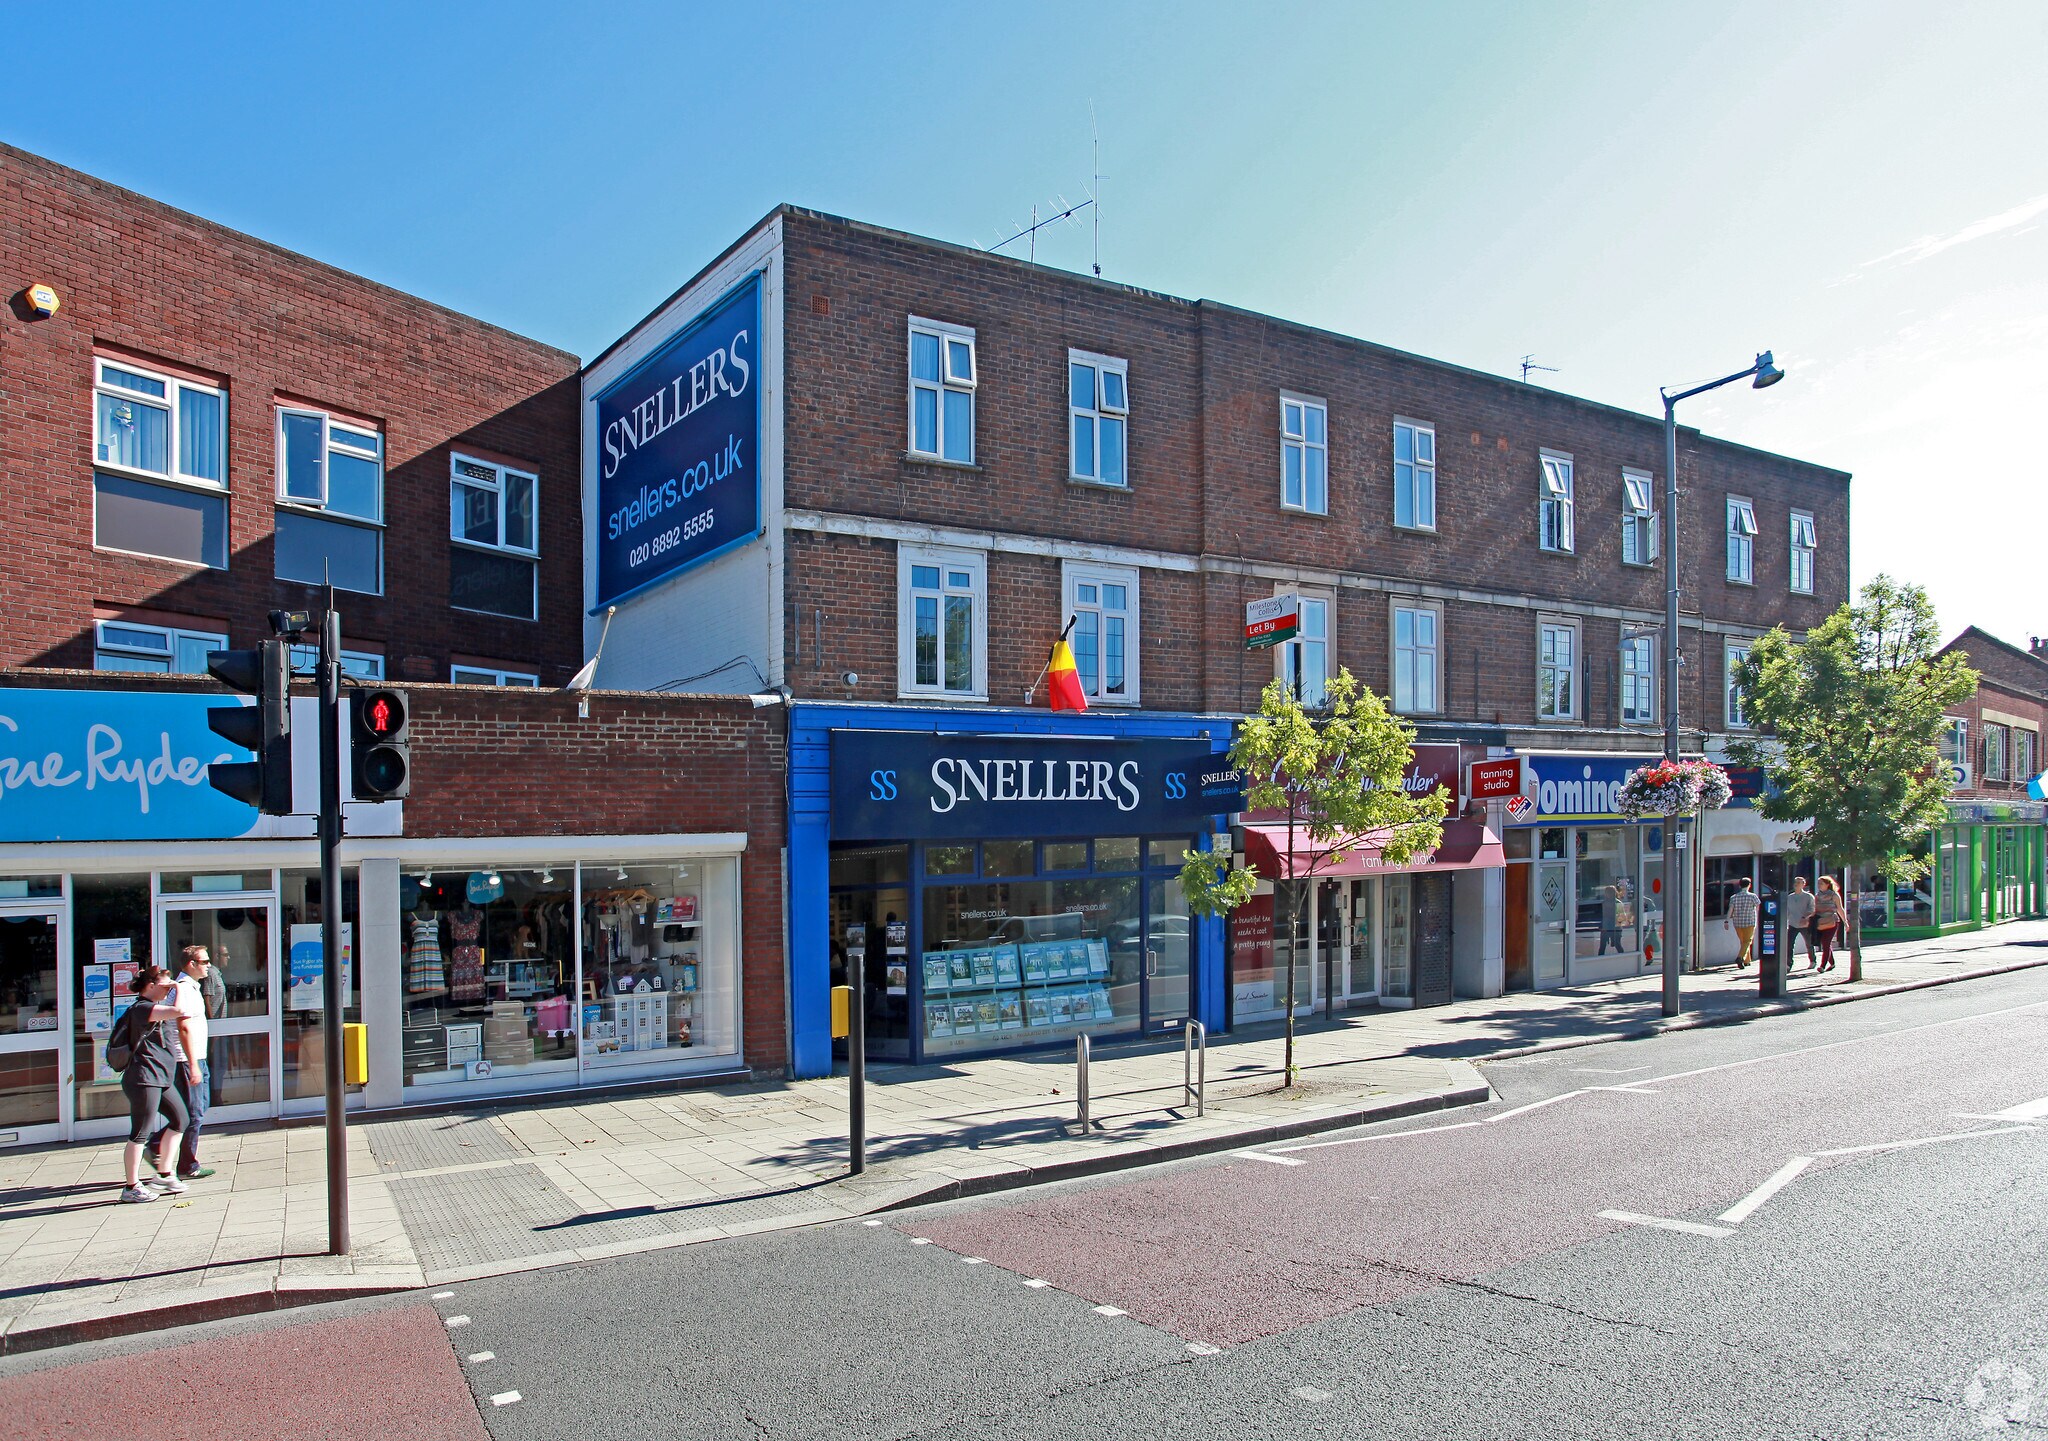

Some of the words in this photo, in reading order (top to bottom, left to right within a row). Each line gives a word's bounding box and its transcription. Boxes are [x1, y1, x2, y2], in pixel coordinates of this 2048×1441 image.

[604, 329, 749, 479] SNELLERS
[608, 433, 743, 540] snellers.co.uk
[629, 542, 649, 567] 020
[652, 526, 680, 557] 8892
[683, 508, 714, 540] 5555
[1249, 600, 1277, 611] Milestone
[1258, 608, 1274, 616] Collis
[1249, 624, 1262, 634] Let
[1264, 621, 1275, 632] By
[1201, 769, 1240, 786] SNELLERS
[1480, 767, 1514, 779] tanning
[870, 770, 897, 800] SS
[930, 757, 1140, 813] SNELLERS
[1165, 772, 1187, 799] SS
[1483, 779, 1510, 790] studio
[1202, 786, 1239, 797] snellers.co.uk
[961, 908, 1007, 919] snellers.co.uk
[1066, 902, 1107, 912] snellers.co.uk
[1768, 902, 1777, 913] P
[1238, 940, 1255, 950] pretty
[1256, 940, 1271, 949] penny
